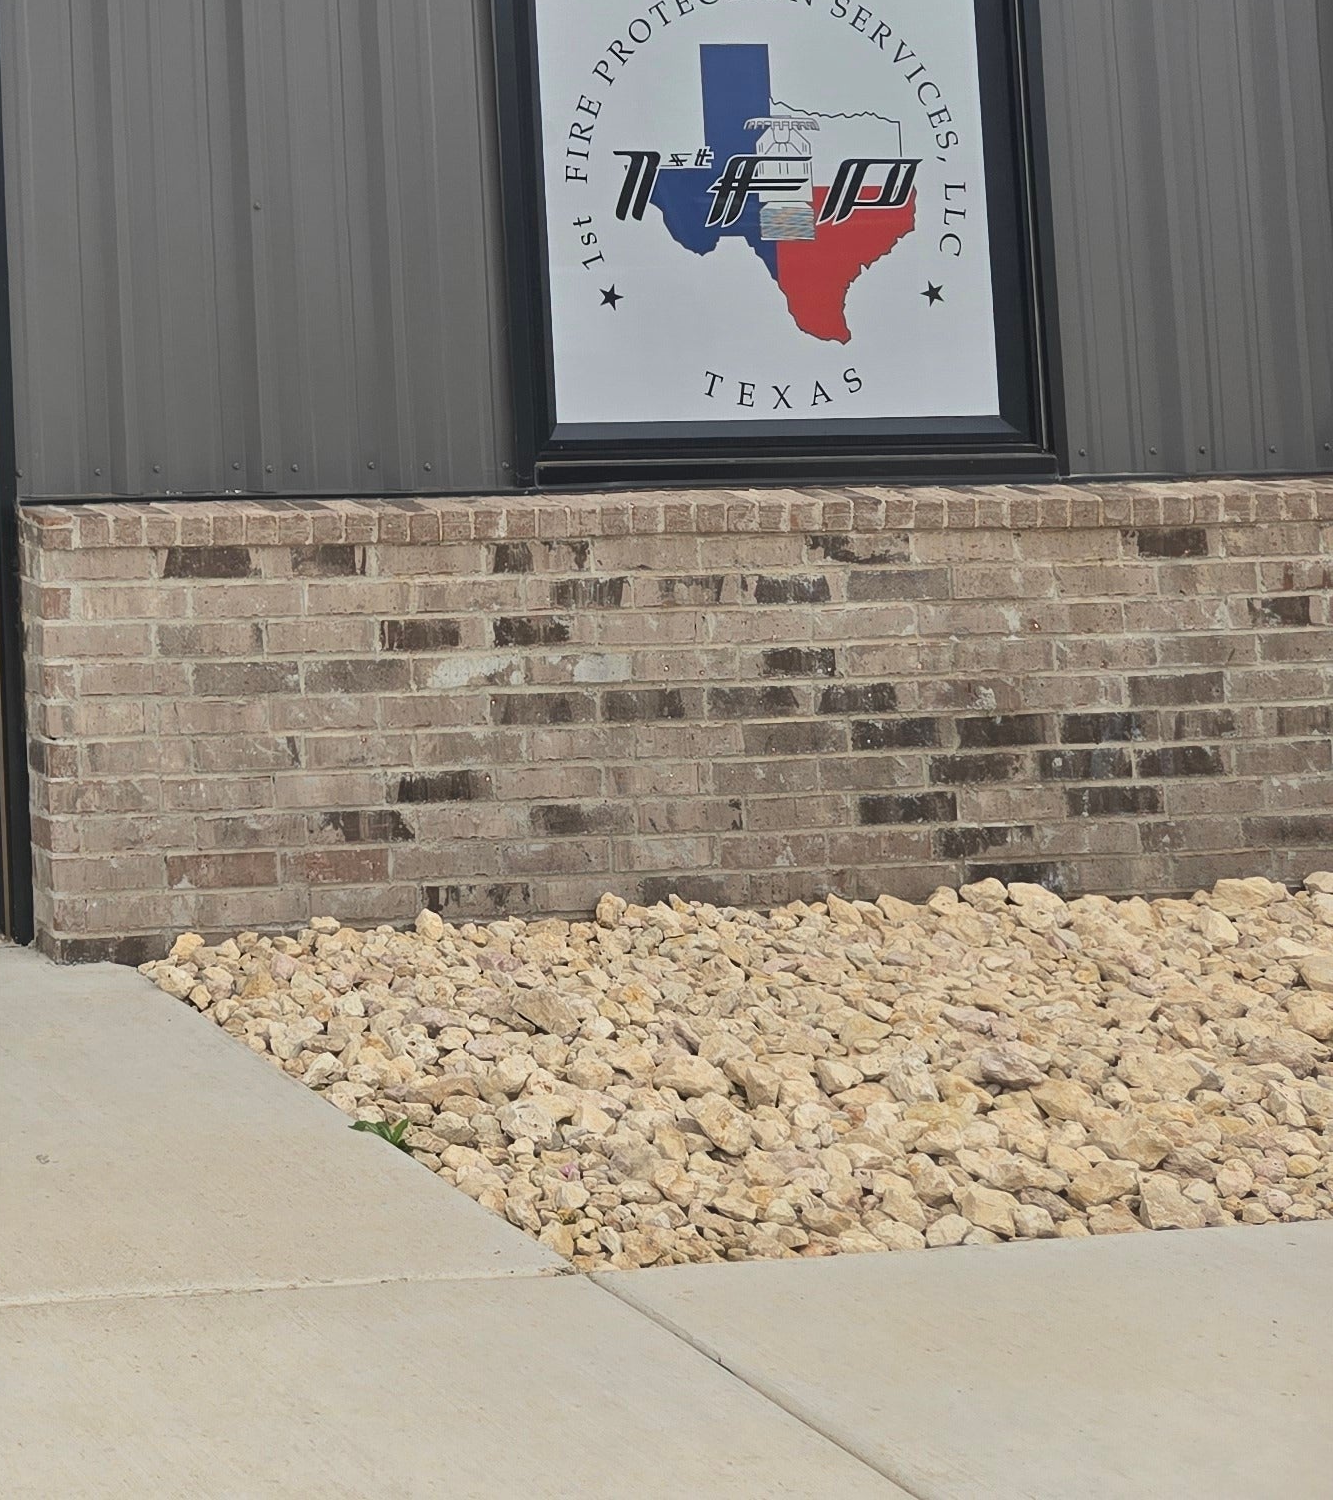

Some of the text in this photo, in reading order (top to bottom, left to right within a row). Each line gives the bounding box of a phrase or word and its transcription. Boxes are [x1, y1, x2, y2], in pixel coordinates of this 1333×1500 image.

[565, 94, 603, 184] FIRE
[572, 215, 606, 271] 1st
[939, 181, 968, 258] LLC
[703, 366, 864, 411] TEXAS
